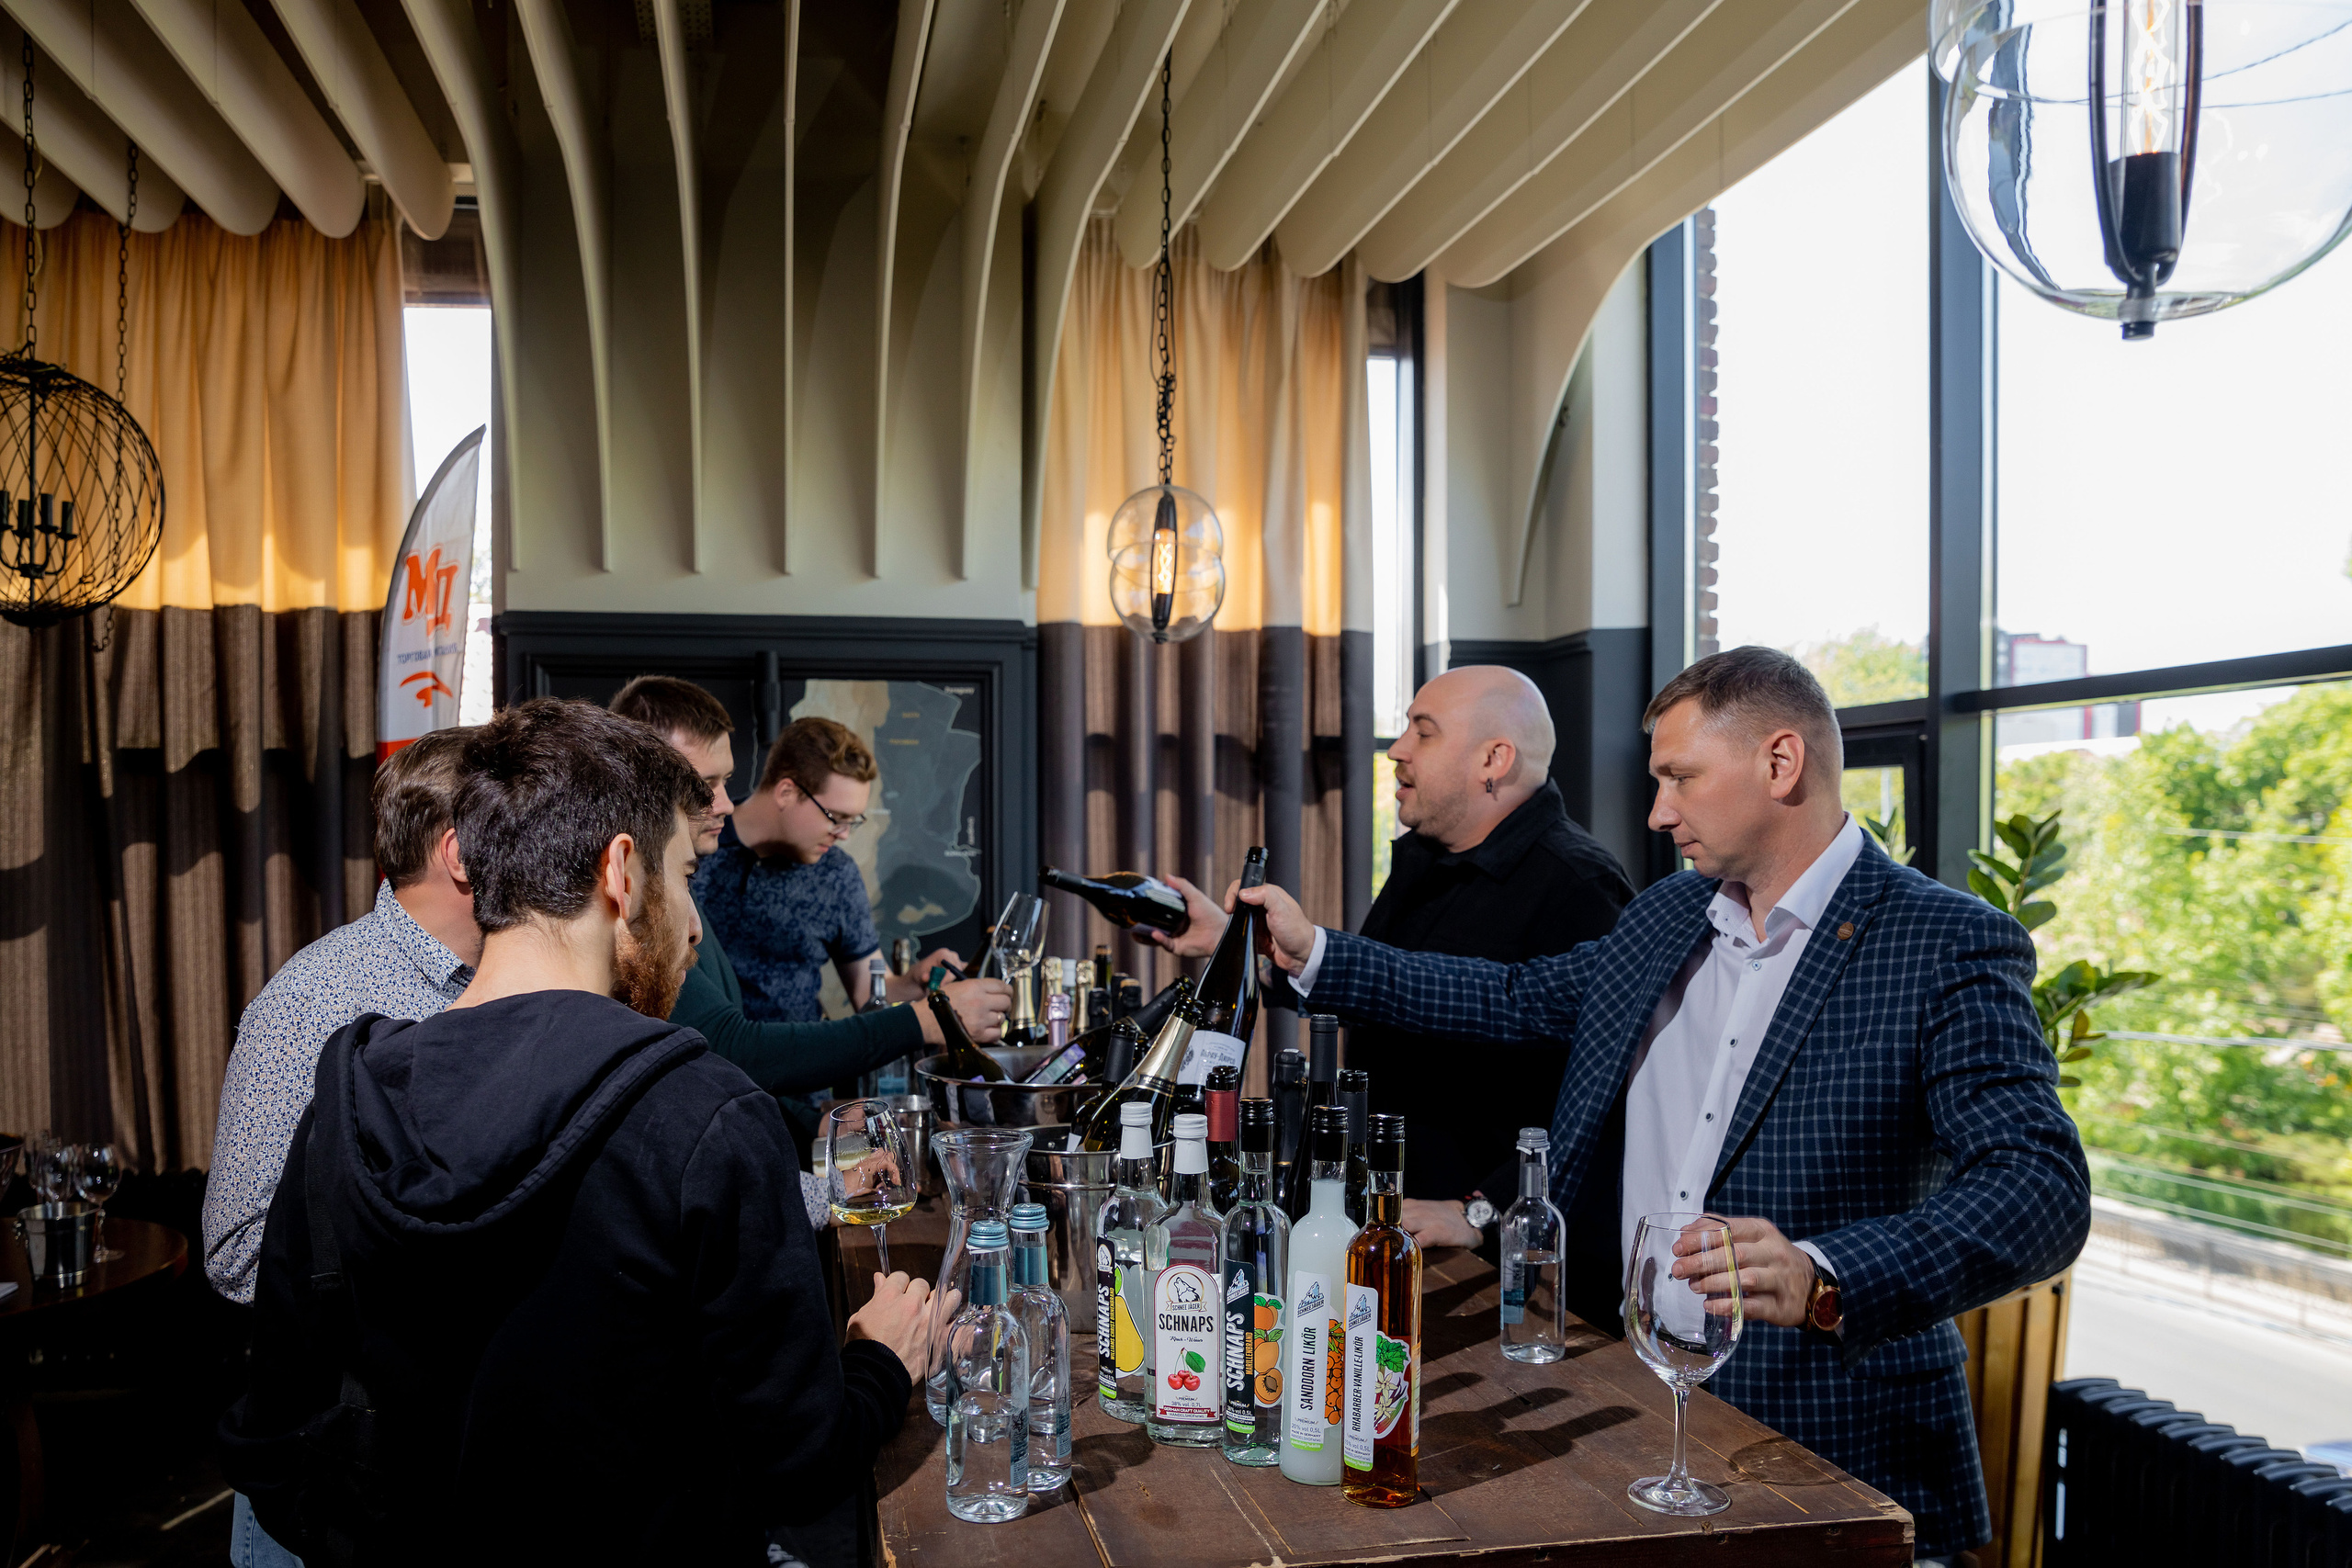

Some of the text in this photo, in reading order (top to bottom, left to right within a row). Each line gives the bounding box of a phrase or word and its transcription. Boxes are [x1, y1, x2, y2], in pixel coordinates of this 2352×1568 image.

[1098, 1283, 1110, 1358] SCHNAPS
[1159, 1313, 1214, 1333] SCHNAPS
[1226, 1310, 1245, 1391] SCHNAPS
[1245, 1332, 1253, 1375] MARILLENBRAND
[1300, 1326, 1317, 1411] SANDDORN LIKÖR
[1351, 1336, 1363, 1432] RHABARBER-VANILLE-LIKÖR
